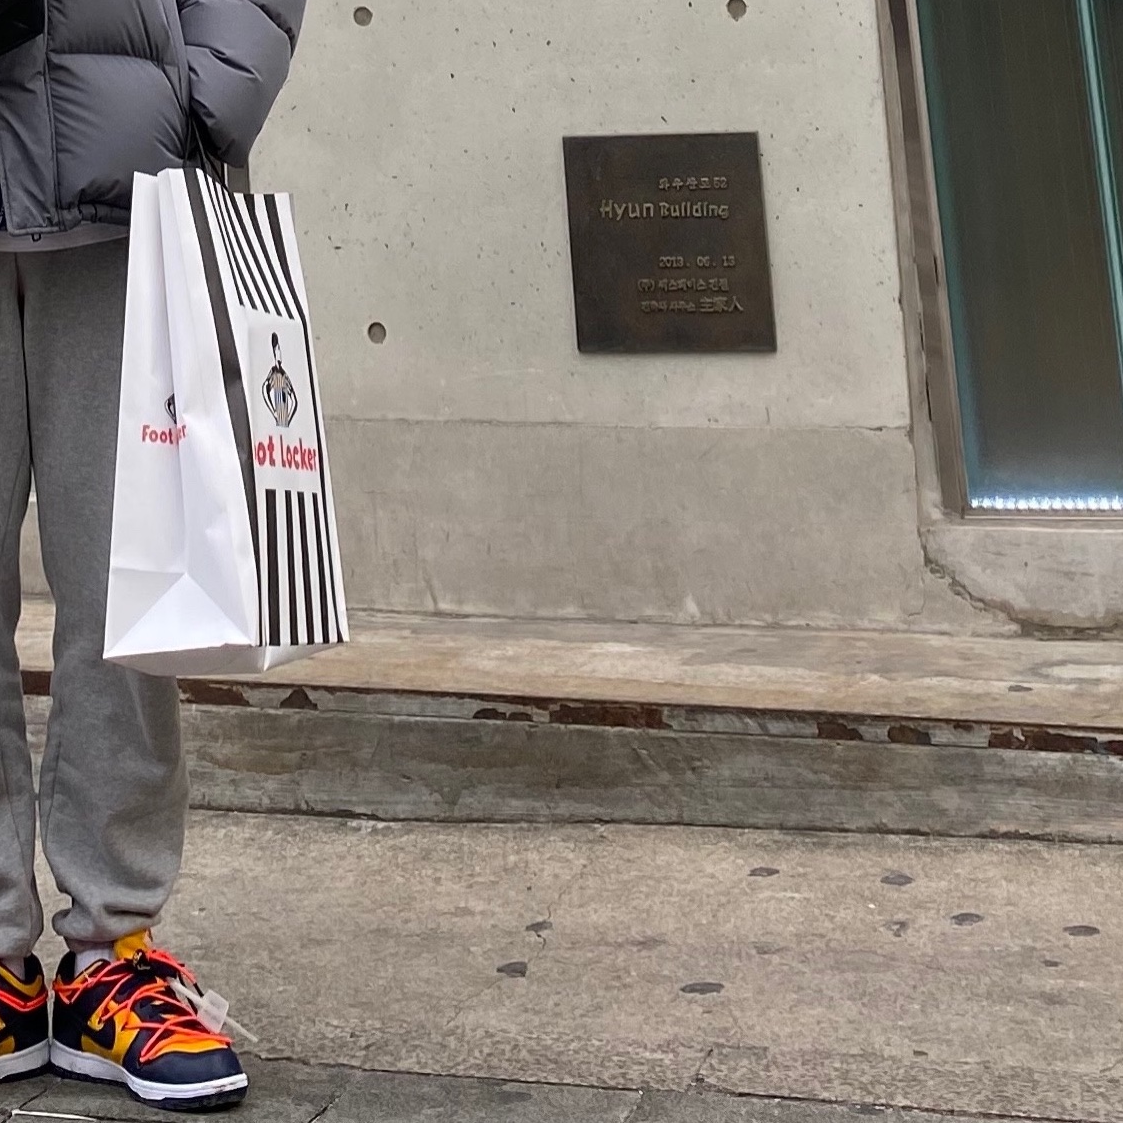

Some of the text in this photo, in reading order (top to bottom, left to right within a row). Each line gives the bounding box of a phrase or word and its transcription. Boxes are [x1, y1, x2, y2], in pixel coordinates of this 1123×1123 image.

[600, 199, 729, 220] Hyun Building
[255, 435, 275, 467] ot
